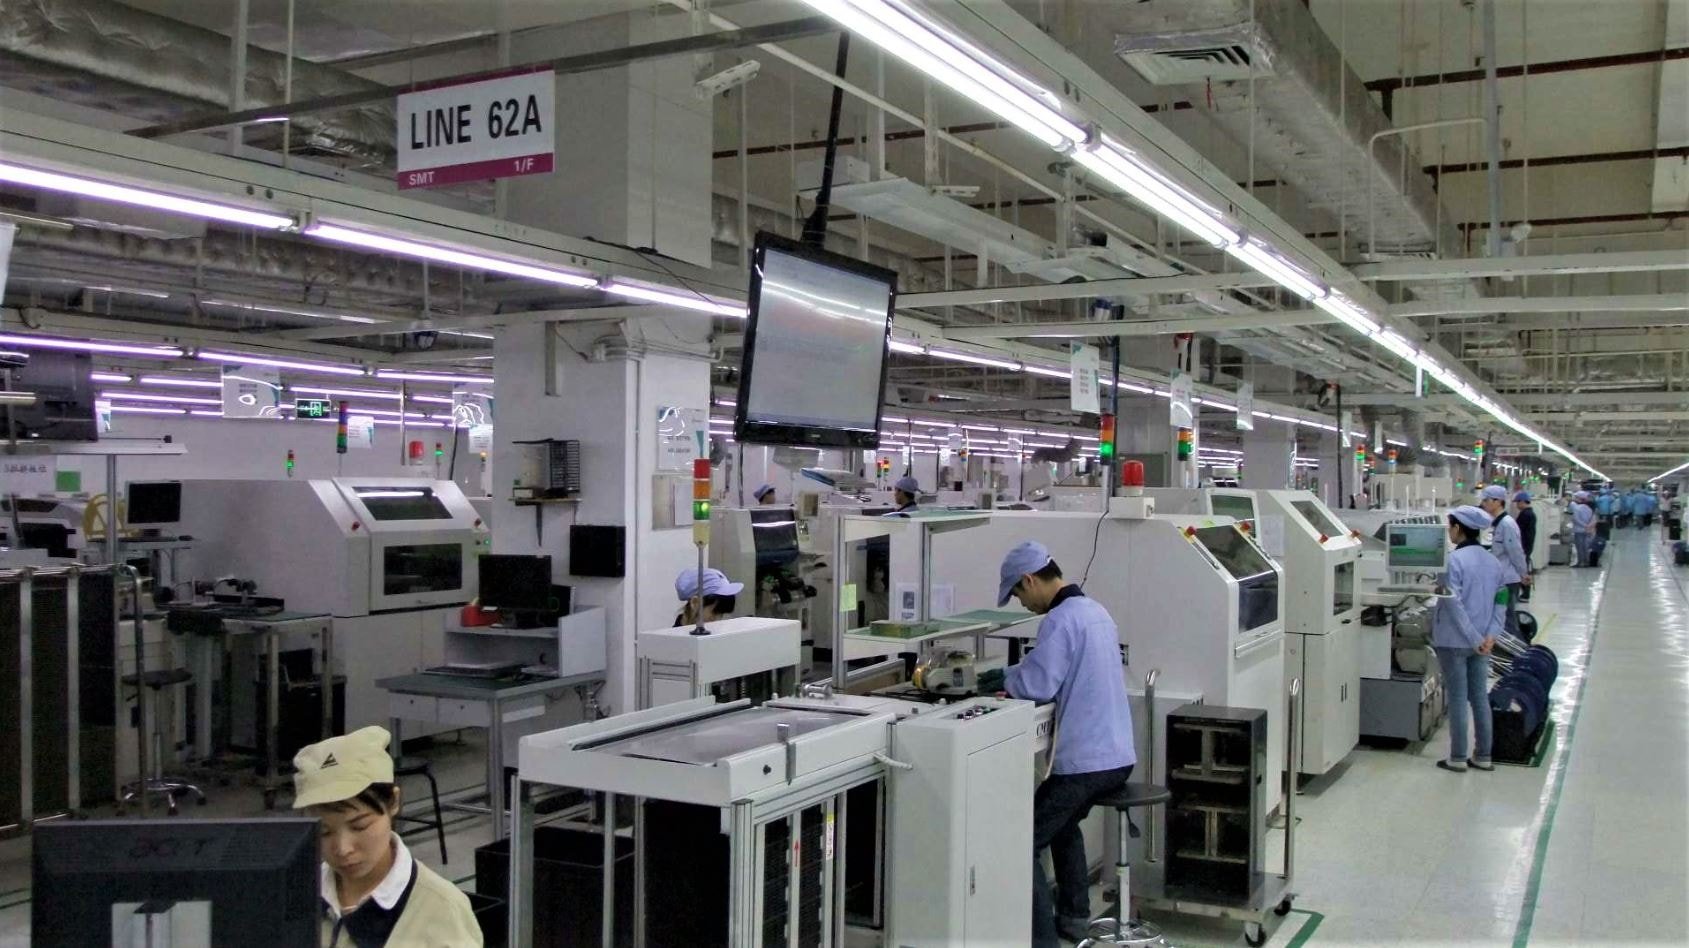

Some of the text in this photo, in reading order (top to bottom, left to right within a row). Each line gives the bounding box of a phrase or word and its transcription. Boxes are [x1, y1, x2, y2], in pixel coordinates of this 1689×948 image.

[411, 94, 542, 150] LINE 62A
[409, 158, 534, 186] SMT 1/F
